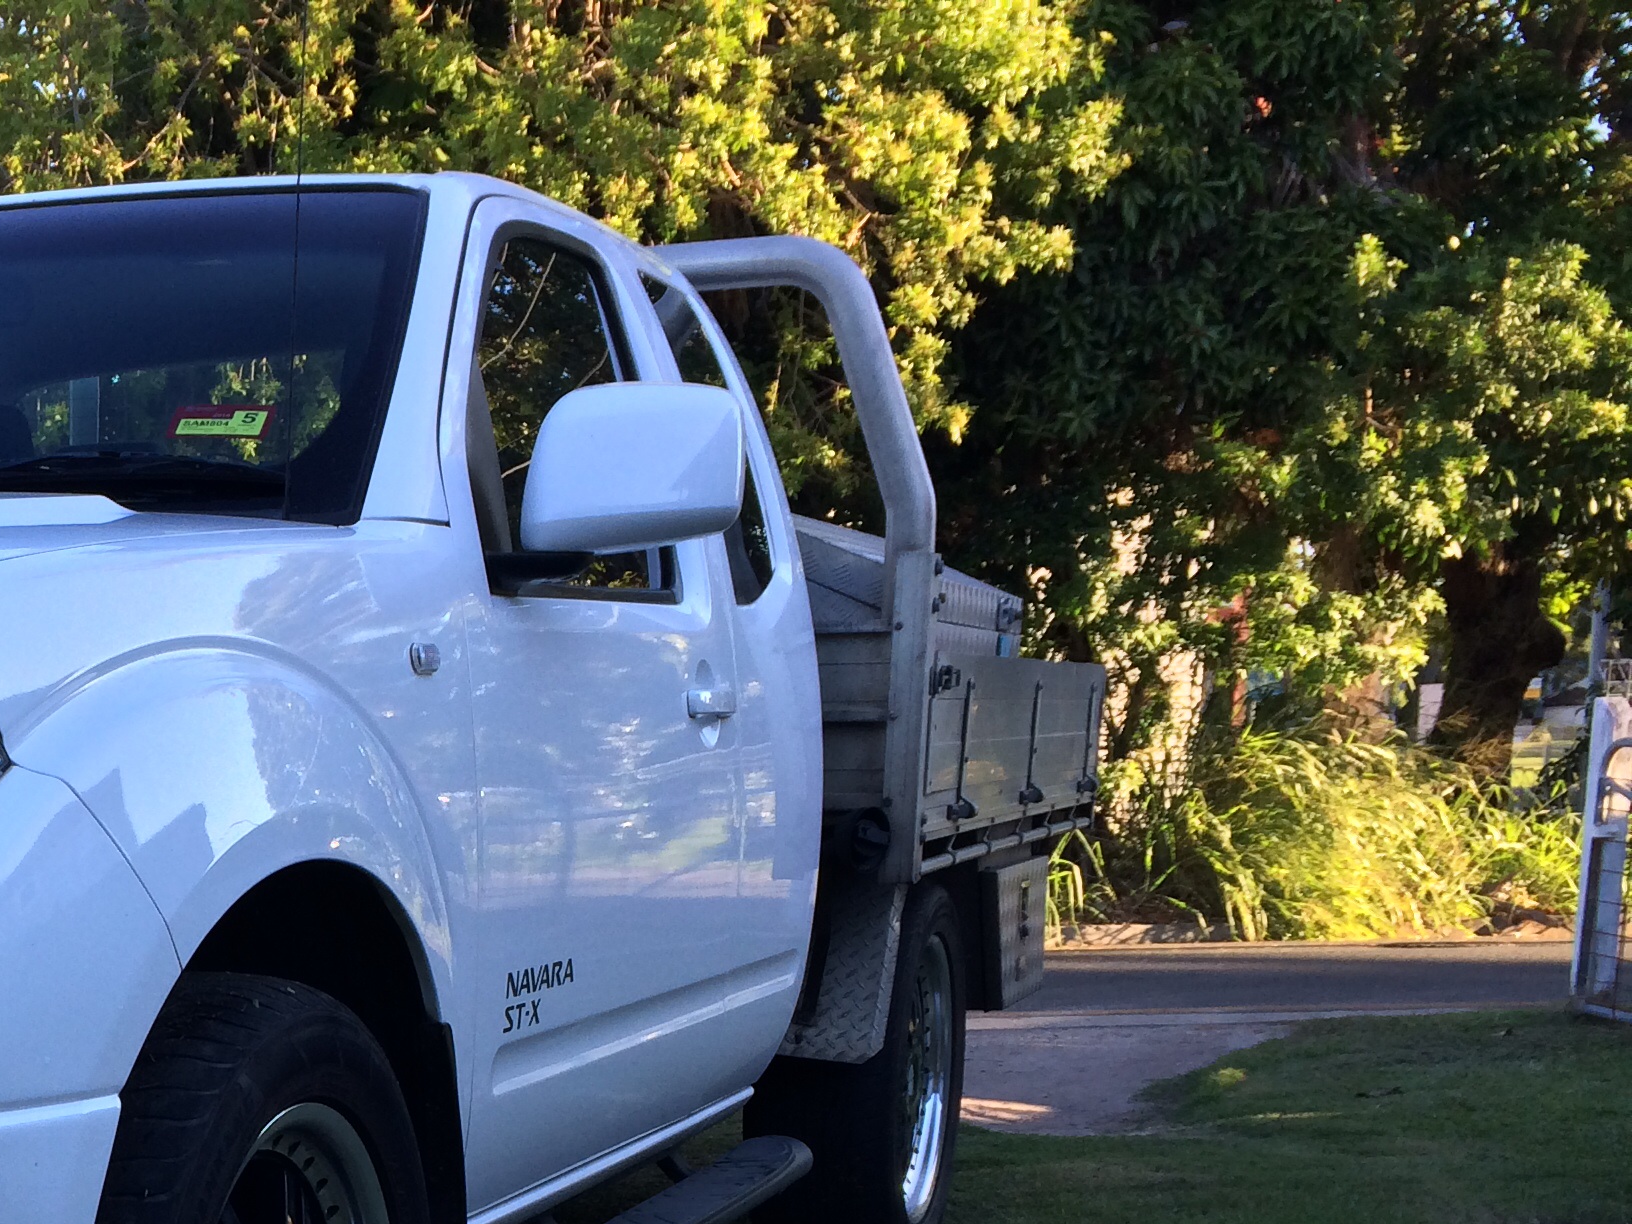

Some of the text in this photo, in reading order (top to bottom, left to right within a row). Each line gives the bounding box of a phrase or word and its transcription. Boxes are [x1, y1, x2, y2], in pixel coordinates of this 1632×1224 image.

[182, 419, 230, 427] SAM804
[241, 412, 259, 424] 5
[505, 958, 574, 999] NAVARA
